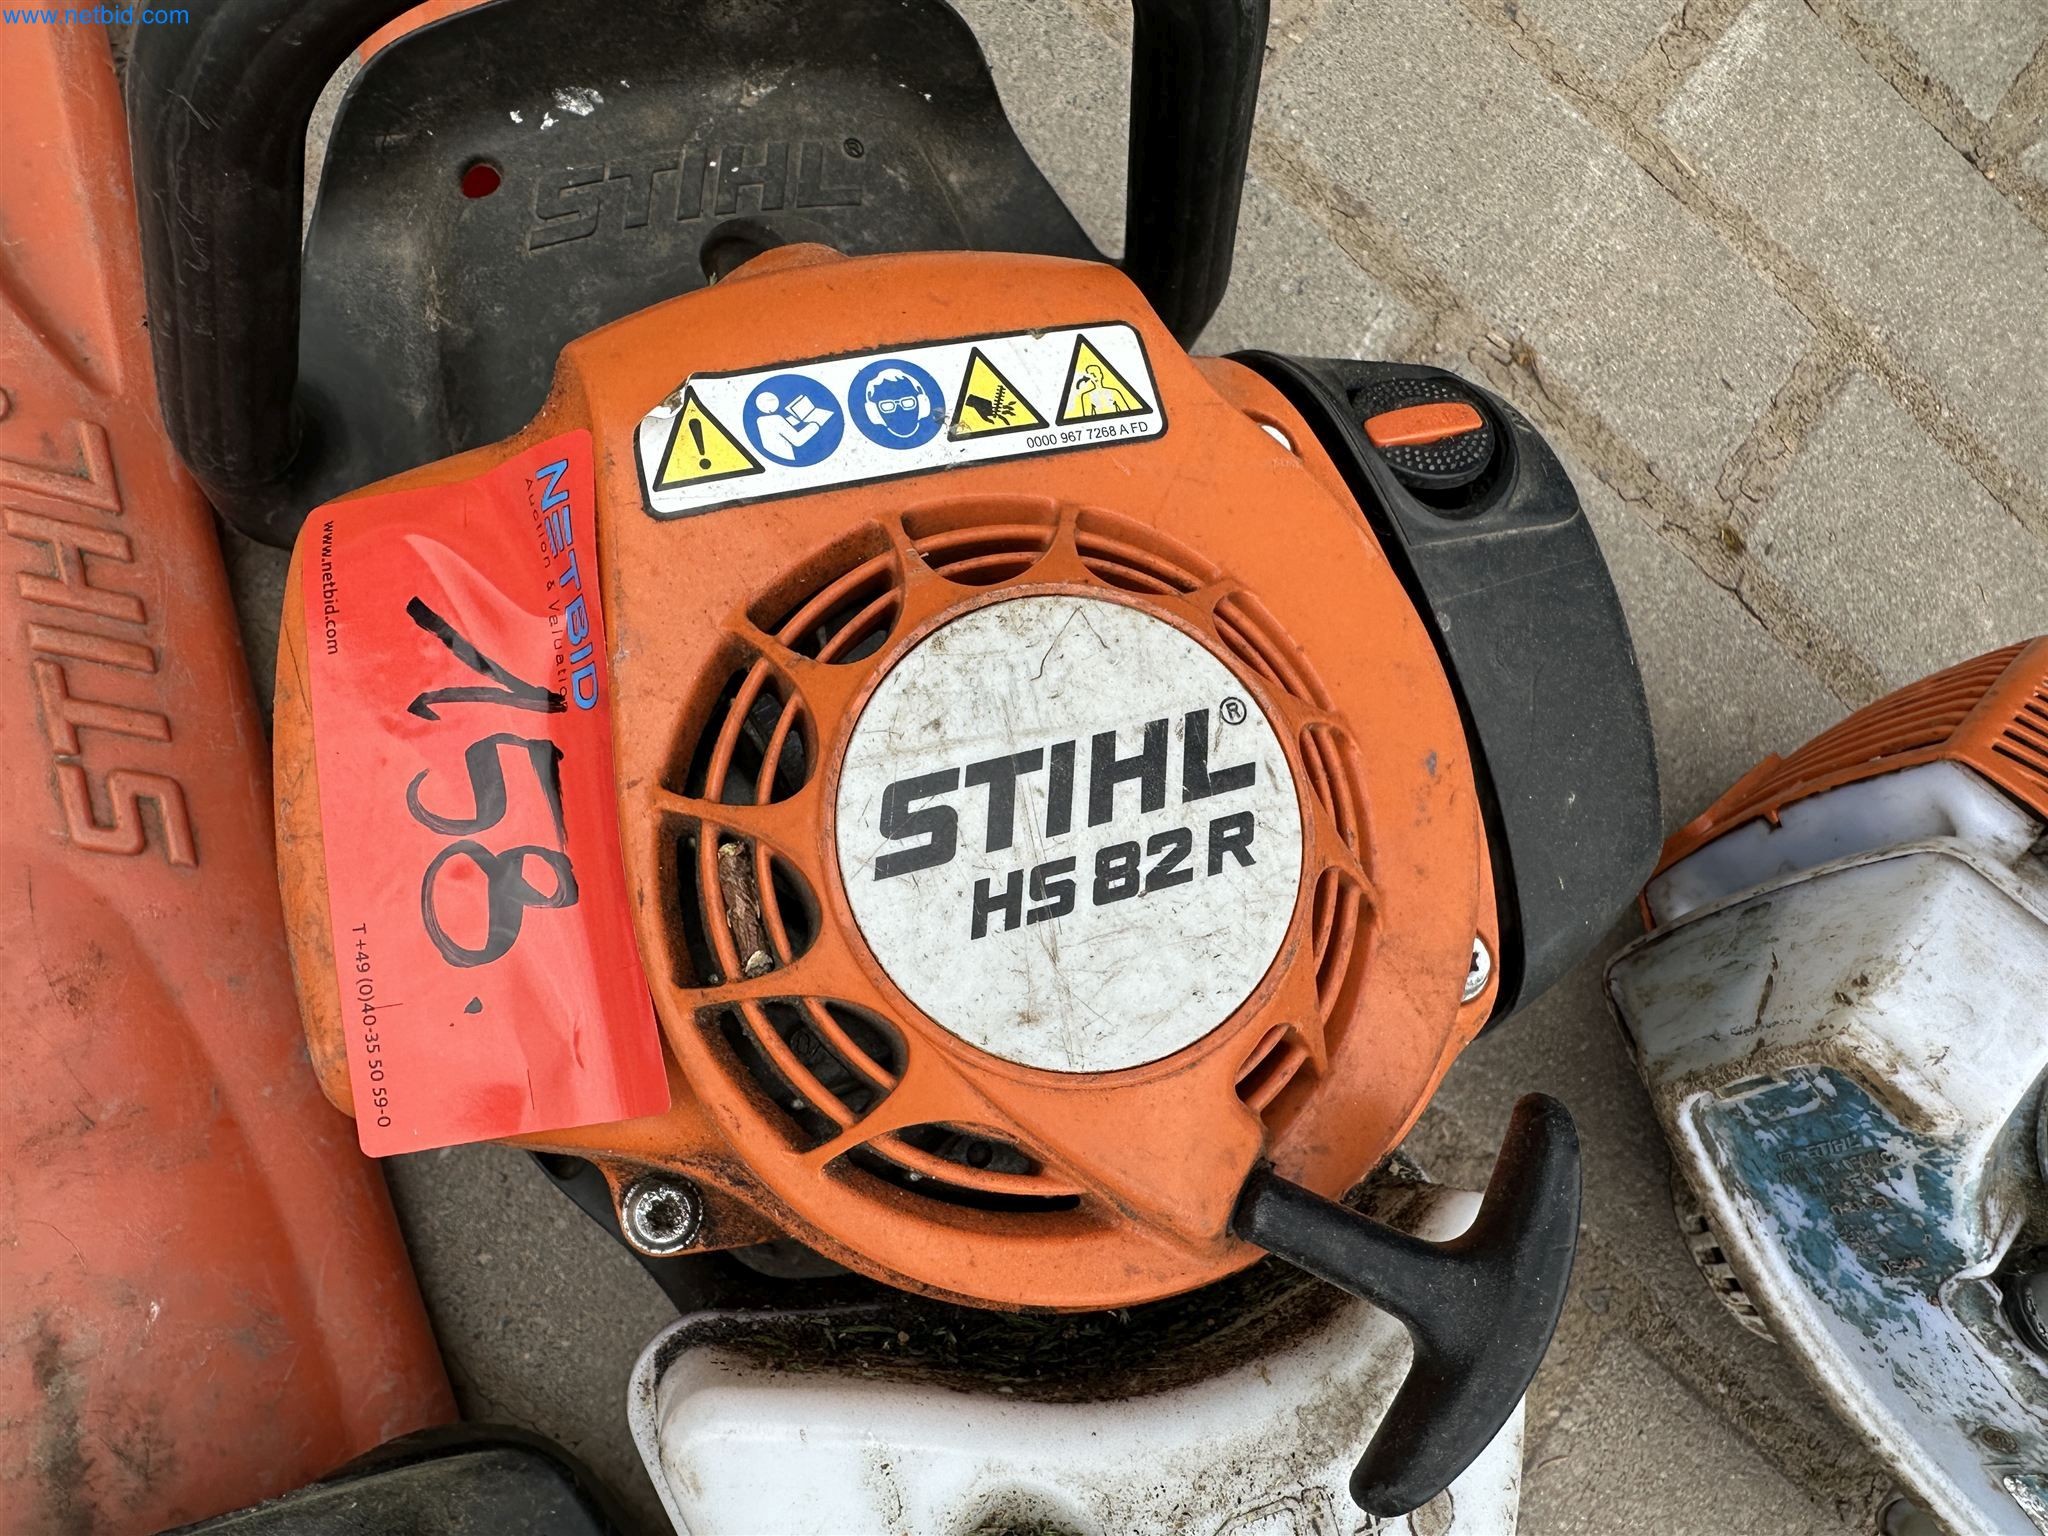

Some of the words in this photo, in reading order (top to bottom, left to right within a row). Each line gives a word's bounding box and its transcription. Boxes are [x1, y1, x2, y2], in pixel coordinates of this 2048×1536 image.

[1026, 434, 1057, 449] 0000
[1060, 430, 1083, 444] 967
[1086, 425, 1117, 439] 7268
[525, 478, 551, 567] Auction
[545, 581, 555, 592] &
[321, 521, 339, 655] www.netbid.com
[536, 459, 599, 710] NETBID
[0, 421, 198, 868] STIHL
[971, 856, 1076, 940] HS
[1093, 827, 1194, 906] 82
[1208, 811, 1257, 876] R
[352, 923, 367, 935] T
[355, 938, 371, 974] +49
[355, 977, 380, 1054] (0)40-35
[368, 1060, 386, 1082] 50
[372, 1087, 392, 1128] 59-0
